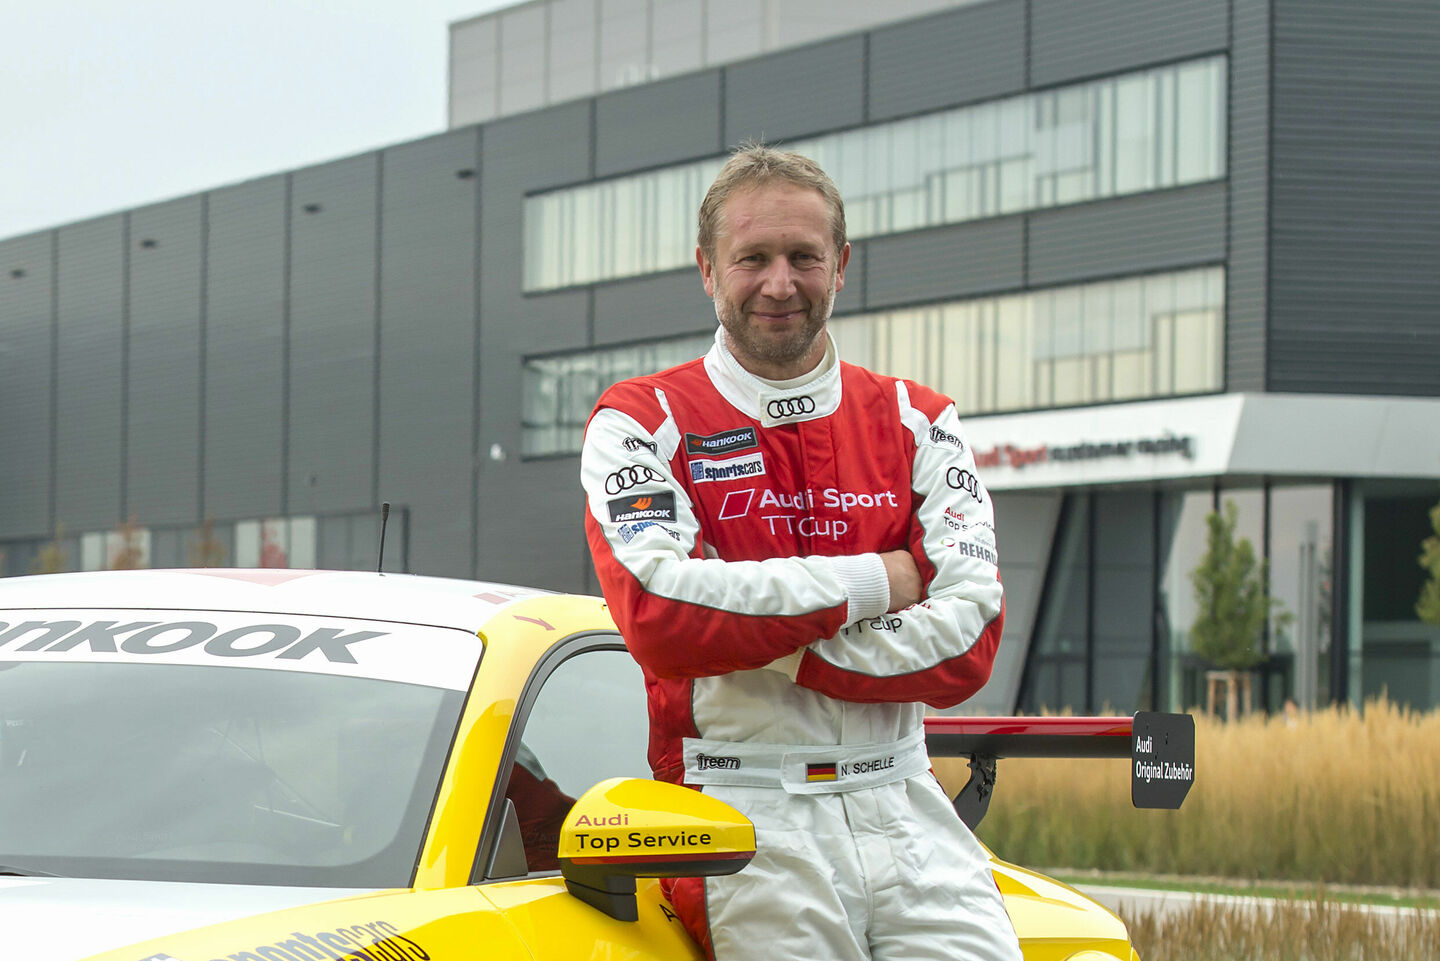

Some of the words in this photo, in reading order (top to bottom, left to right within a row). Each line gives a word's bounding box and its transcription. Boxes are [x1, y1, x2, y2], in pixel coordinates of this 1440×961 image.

[759, 488, 814, 511] Audi
[823, 488, 898, 512] Sport
[945, 506, 964, 522] Audi
[761, 515, 796, 535] TT
[798, 516, 848, 541] Cup
[1136, 736, 1152, 753] Audi
[697, 753, 740, 770] freem
[841, 765, 850, 776] N.
[853, 756, 894, 775] SCHELLE
[1136, 761, 1163, 783] Original
[575, 814, 628, 827] Audi
[576, 834, 620, 852] Top
[628, 832, 711, 848] Service
